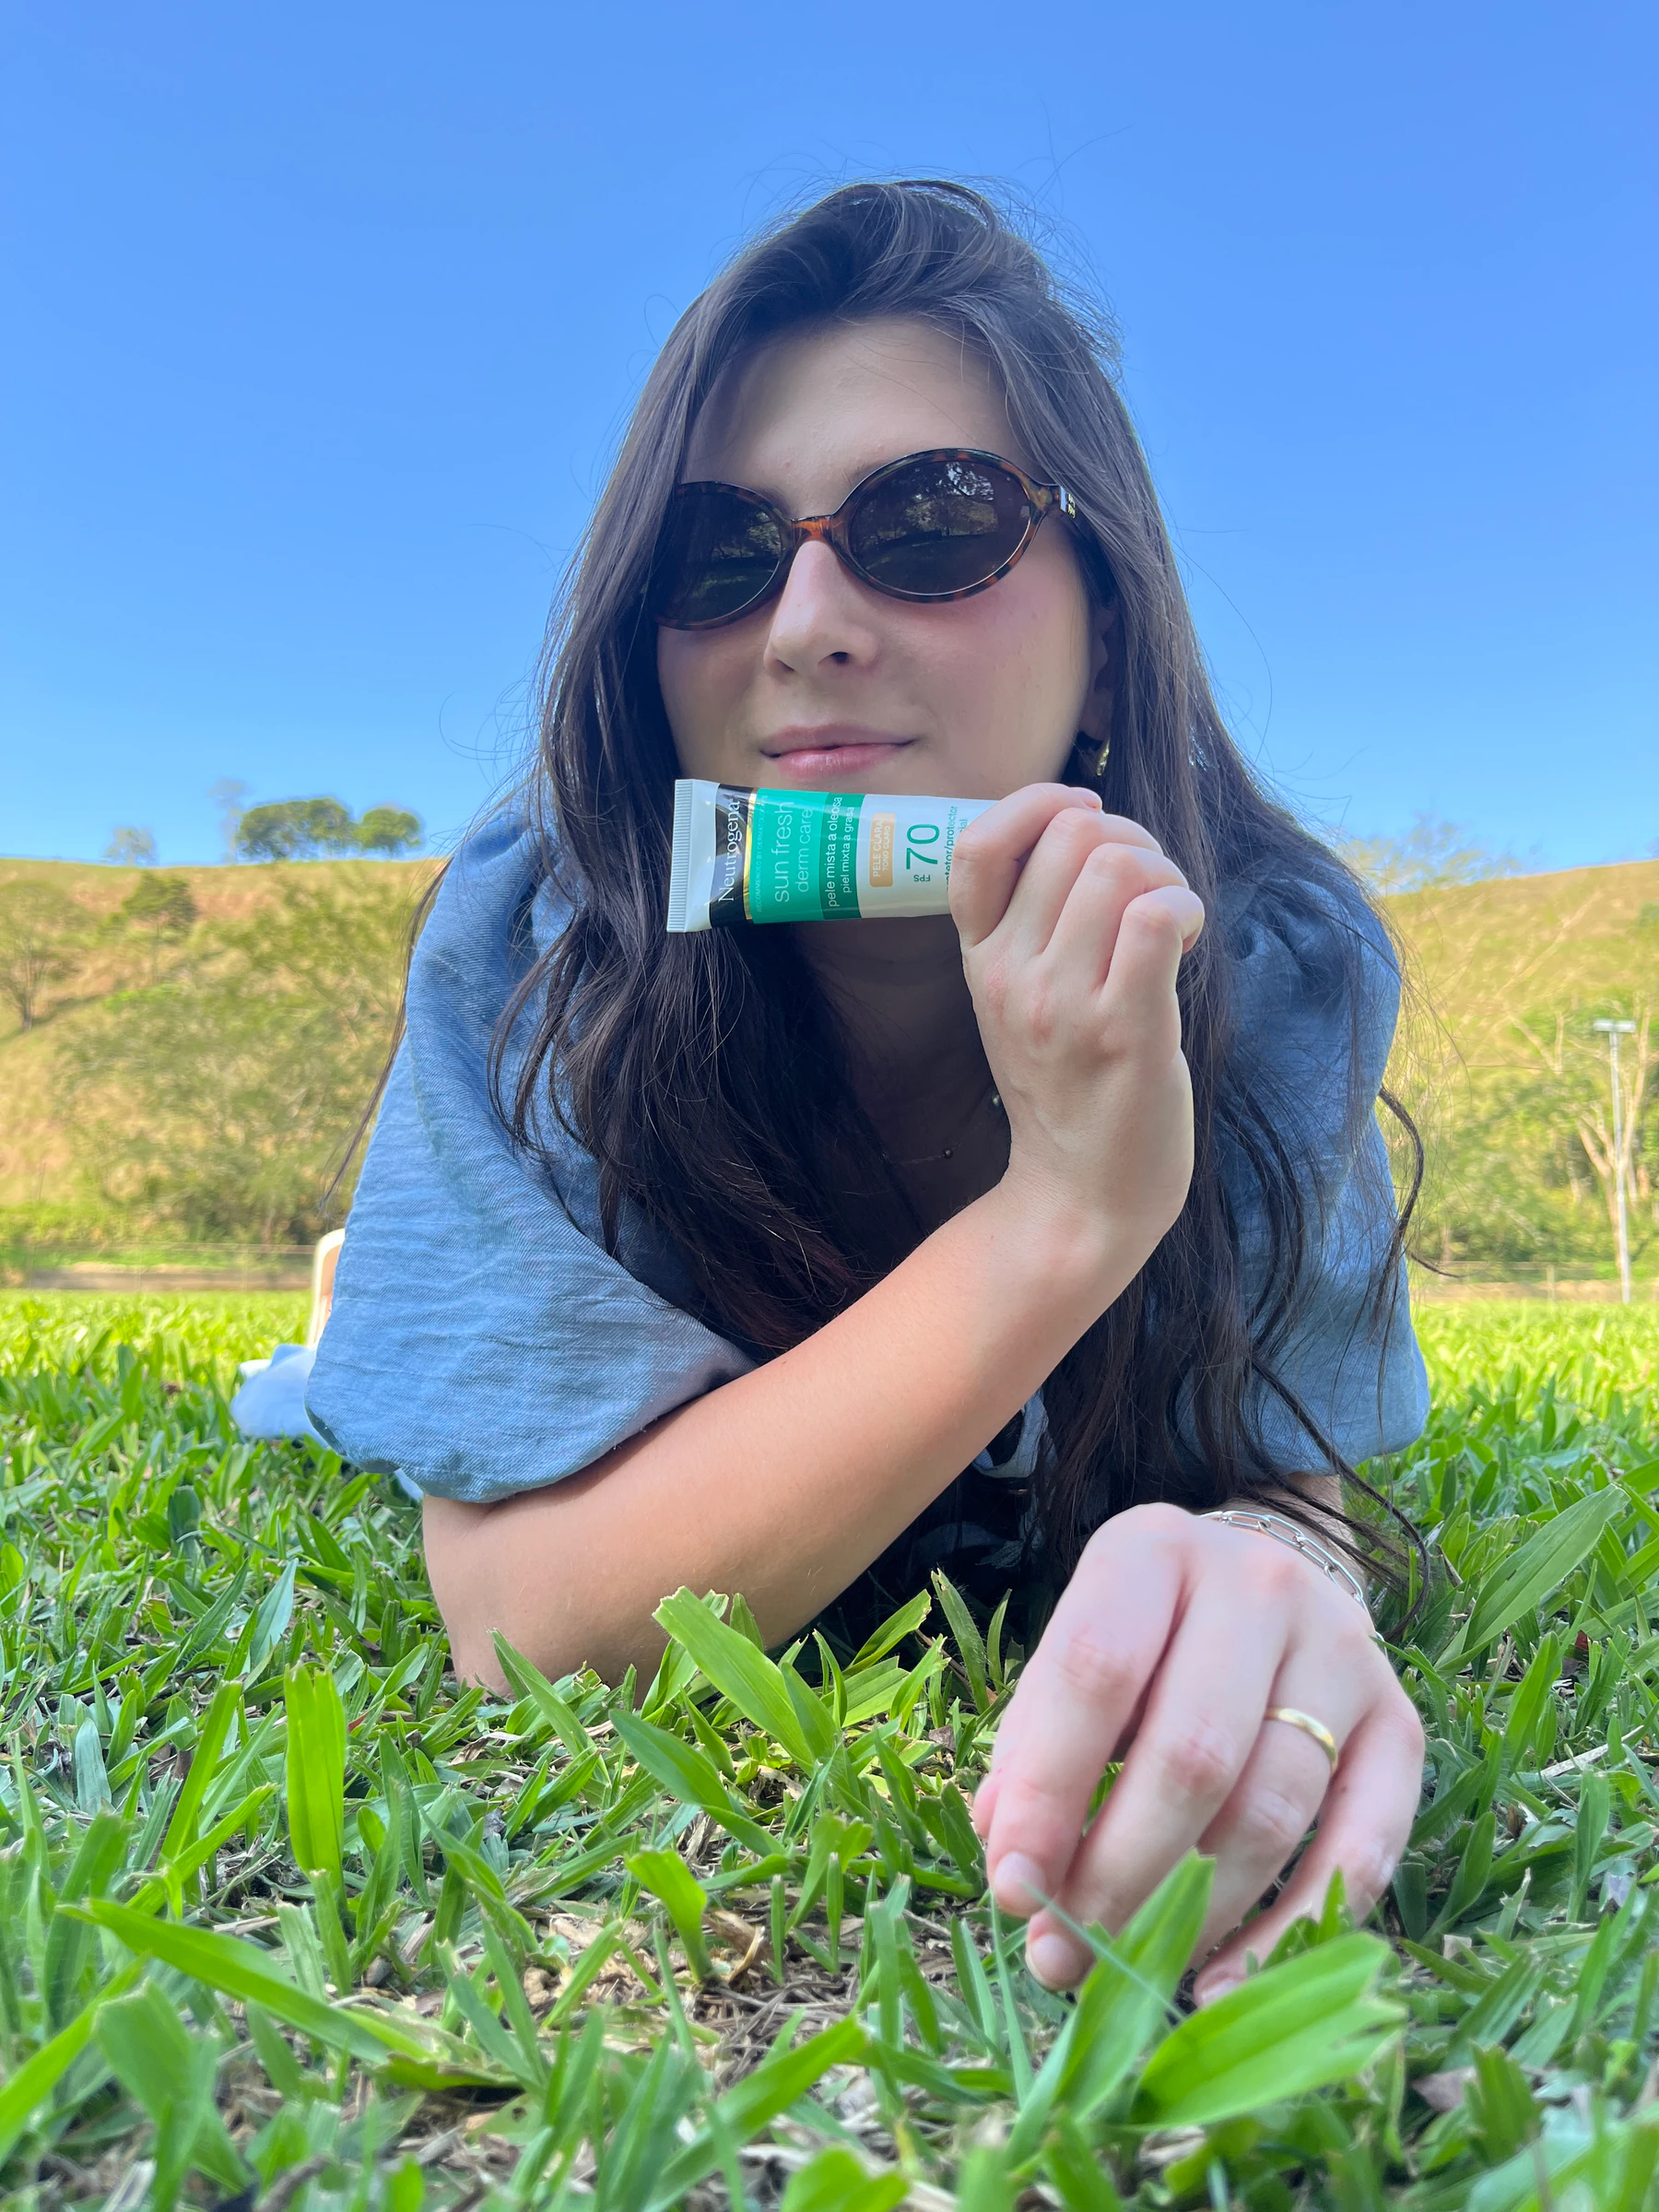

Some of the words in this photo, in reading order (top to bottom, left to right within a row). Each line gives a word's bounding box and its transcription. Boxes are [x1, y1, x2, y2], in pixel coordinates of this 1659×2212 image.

[771, 802, 794, 855] fresh
[799, 809, 813, 843] care
[828, 796, 842, 830] oleosa
[843, 806, 854, 832] grasa
[718, 800, 743, 902] Neutrogena
[873, 820, 883, 852] CLARA
[882, 825, 891, 849] CLARO
[906, 823, 940, 870] 70
[795, 848, 810, 892] derm
[825, 843, 837, 878] mista
[841, 842, 851, 872] mixta
[873, 853, 881, 877] PELE
[773, 862, 790, 902] sun
[826, 881, 841, 907] pele
[841, 874, 853, 893] piel
[913, 874, 931, 882] FPS
